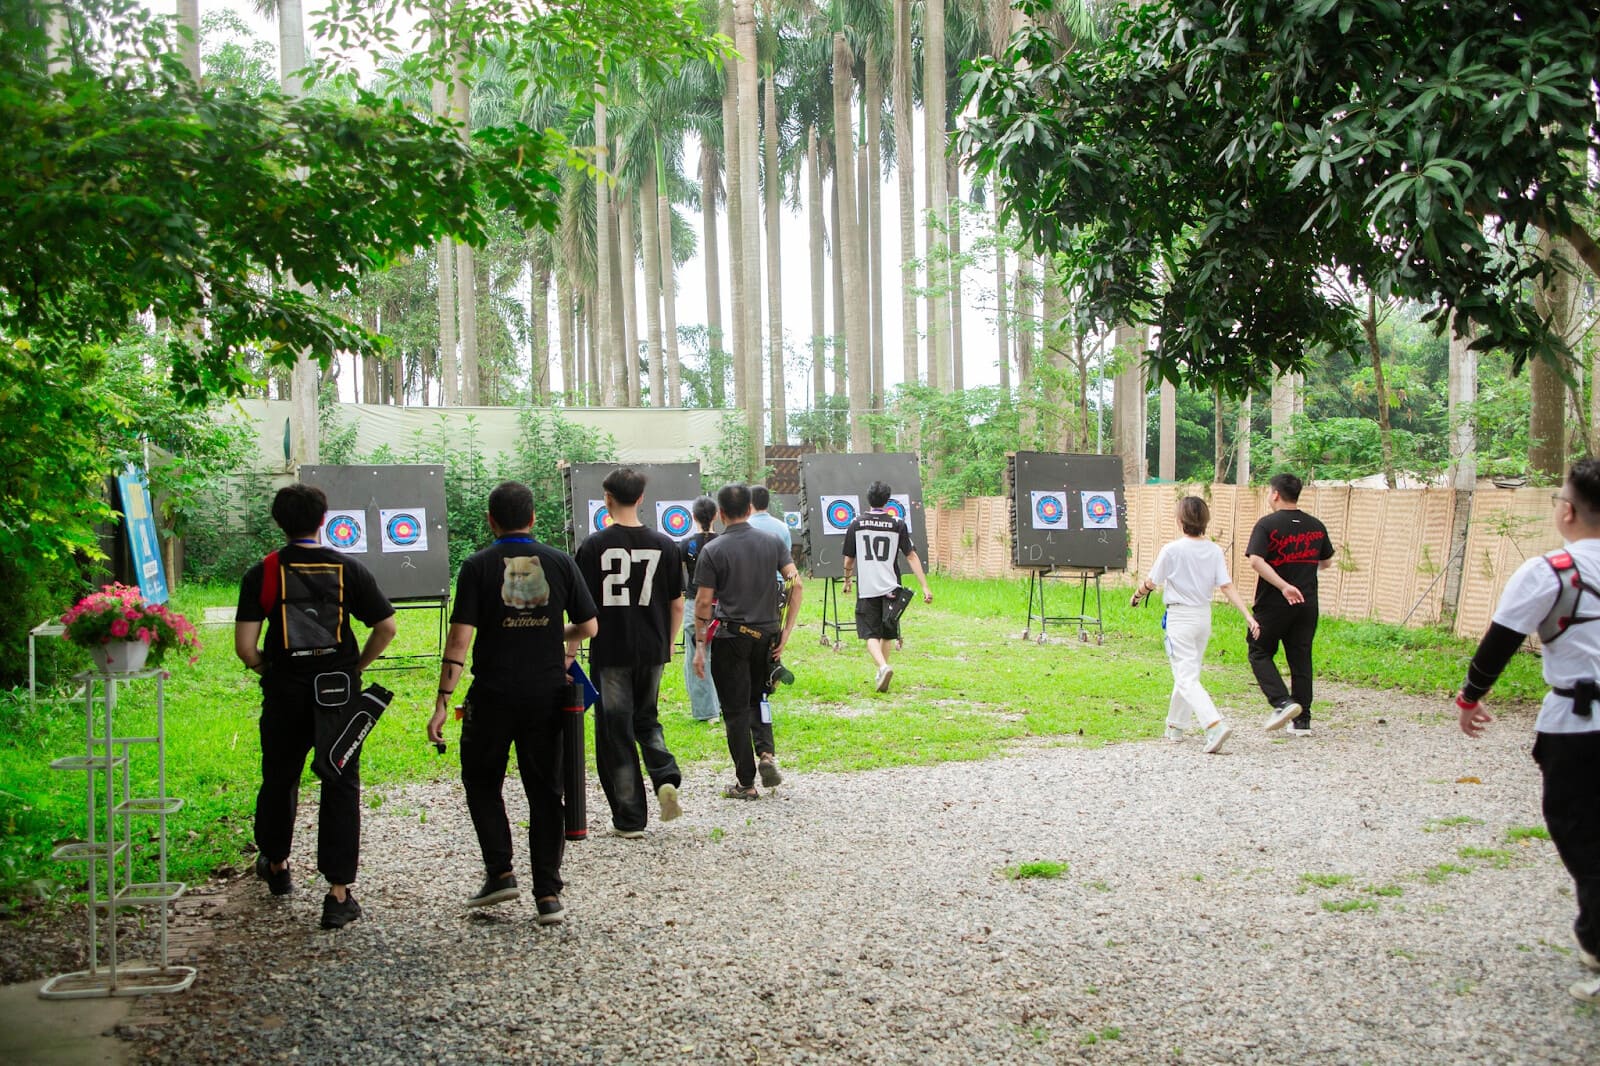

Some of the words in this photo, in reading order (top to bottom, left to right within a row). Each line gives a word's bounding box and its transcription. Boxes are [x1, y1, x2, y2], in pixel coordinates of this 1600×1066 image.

[1097, 530, 1109, 544] 2
[862, 534, 891, 562] 10
[1030, 544, 1043, 561] D
[400, 555, 417, 569] 2
[600, 547, 662, 607] 27
[502, 615, 550, 629] Cattitude
